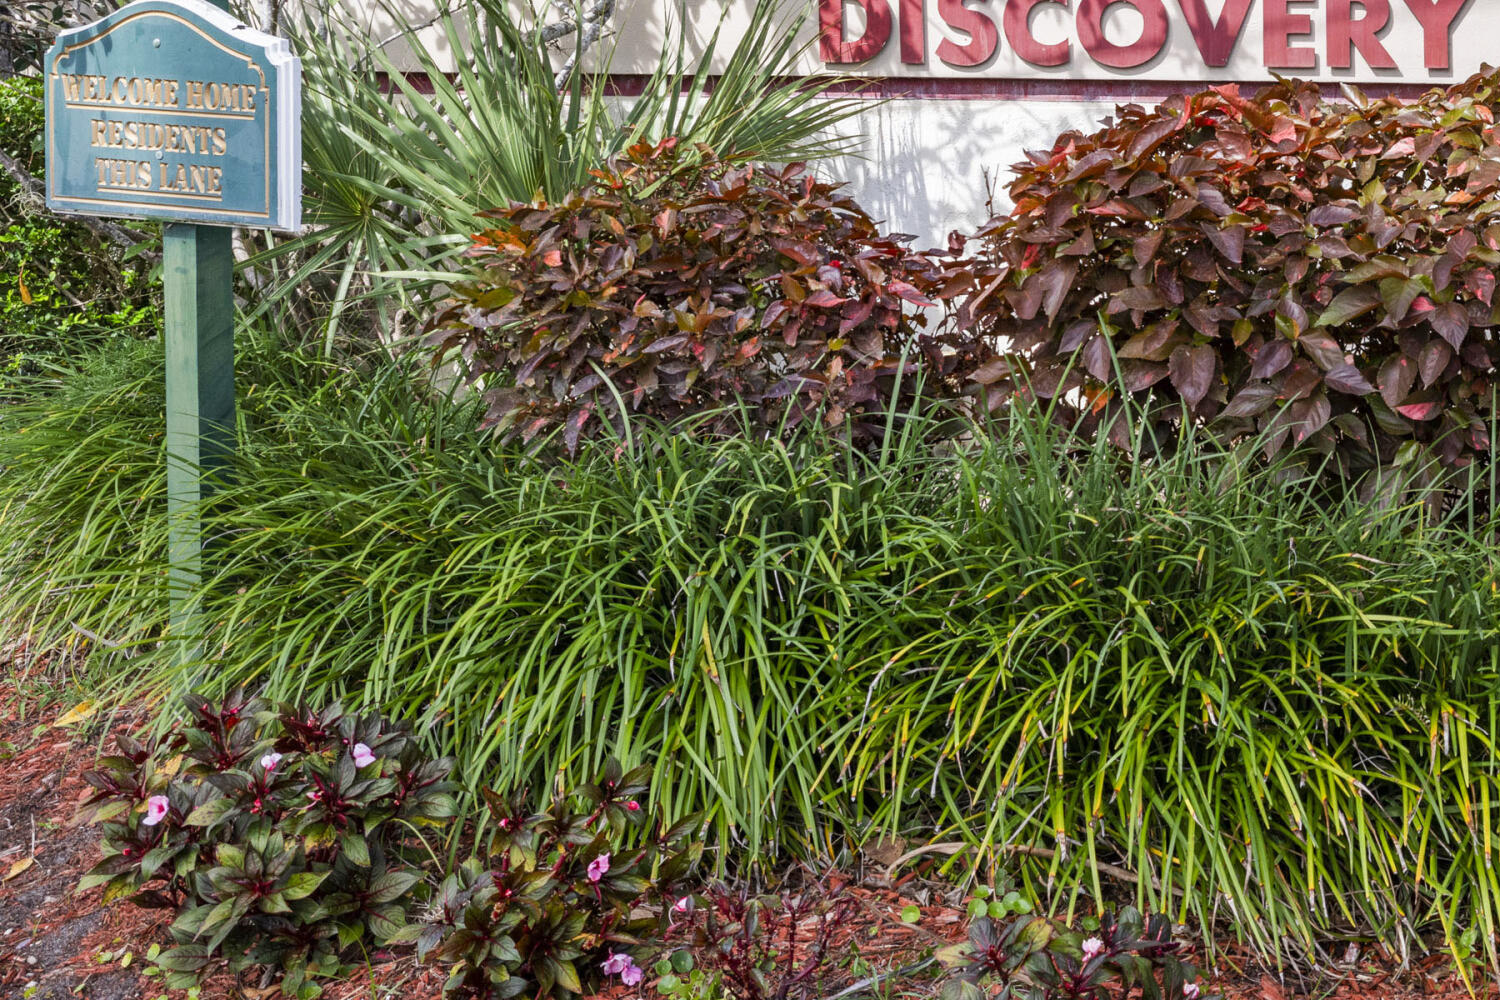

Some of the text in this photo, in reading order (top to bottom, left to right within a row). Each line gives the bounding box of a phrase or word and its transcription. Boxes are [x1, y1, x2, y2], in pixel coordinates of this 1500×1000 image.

[61, 73, 256, 113] WELCOME HOME
[91, 119, 226, 156] RESIDENTS
[95, 157, 223, 195] THIS LANE
